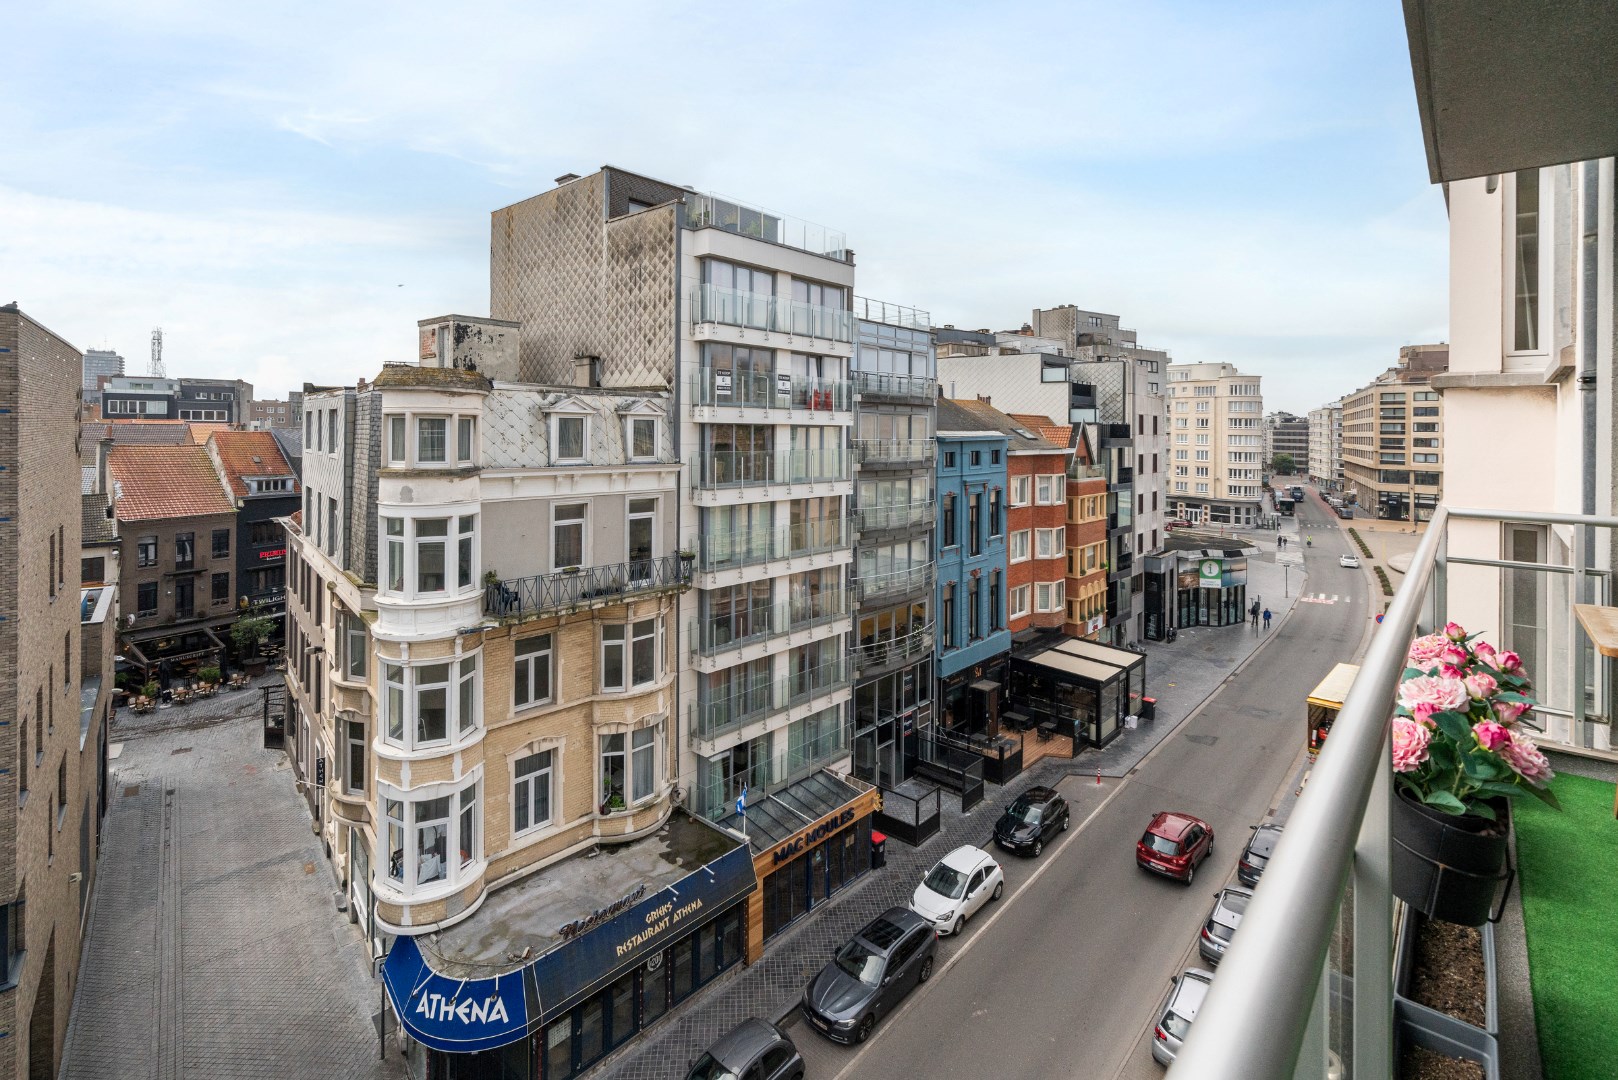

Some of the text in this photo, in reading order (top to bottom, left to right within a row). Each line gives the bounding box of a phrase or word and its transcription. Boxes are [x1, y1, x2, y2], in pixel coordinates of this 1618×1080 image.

[773, 807, 855, 865] MAC MOULES
[616, 898, 703, 957] RESTAURANT ATHENA
[645, 901, 673, 924] GRIEKS
[415, 988, 509, 1025] ATHENA
